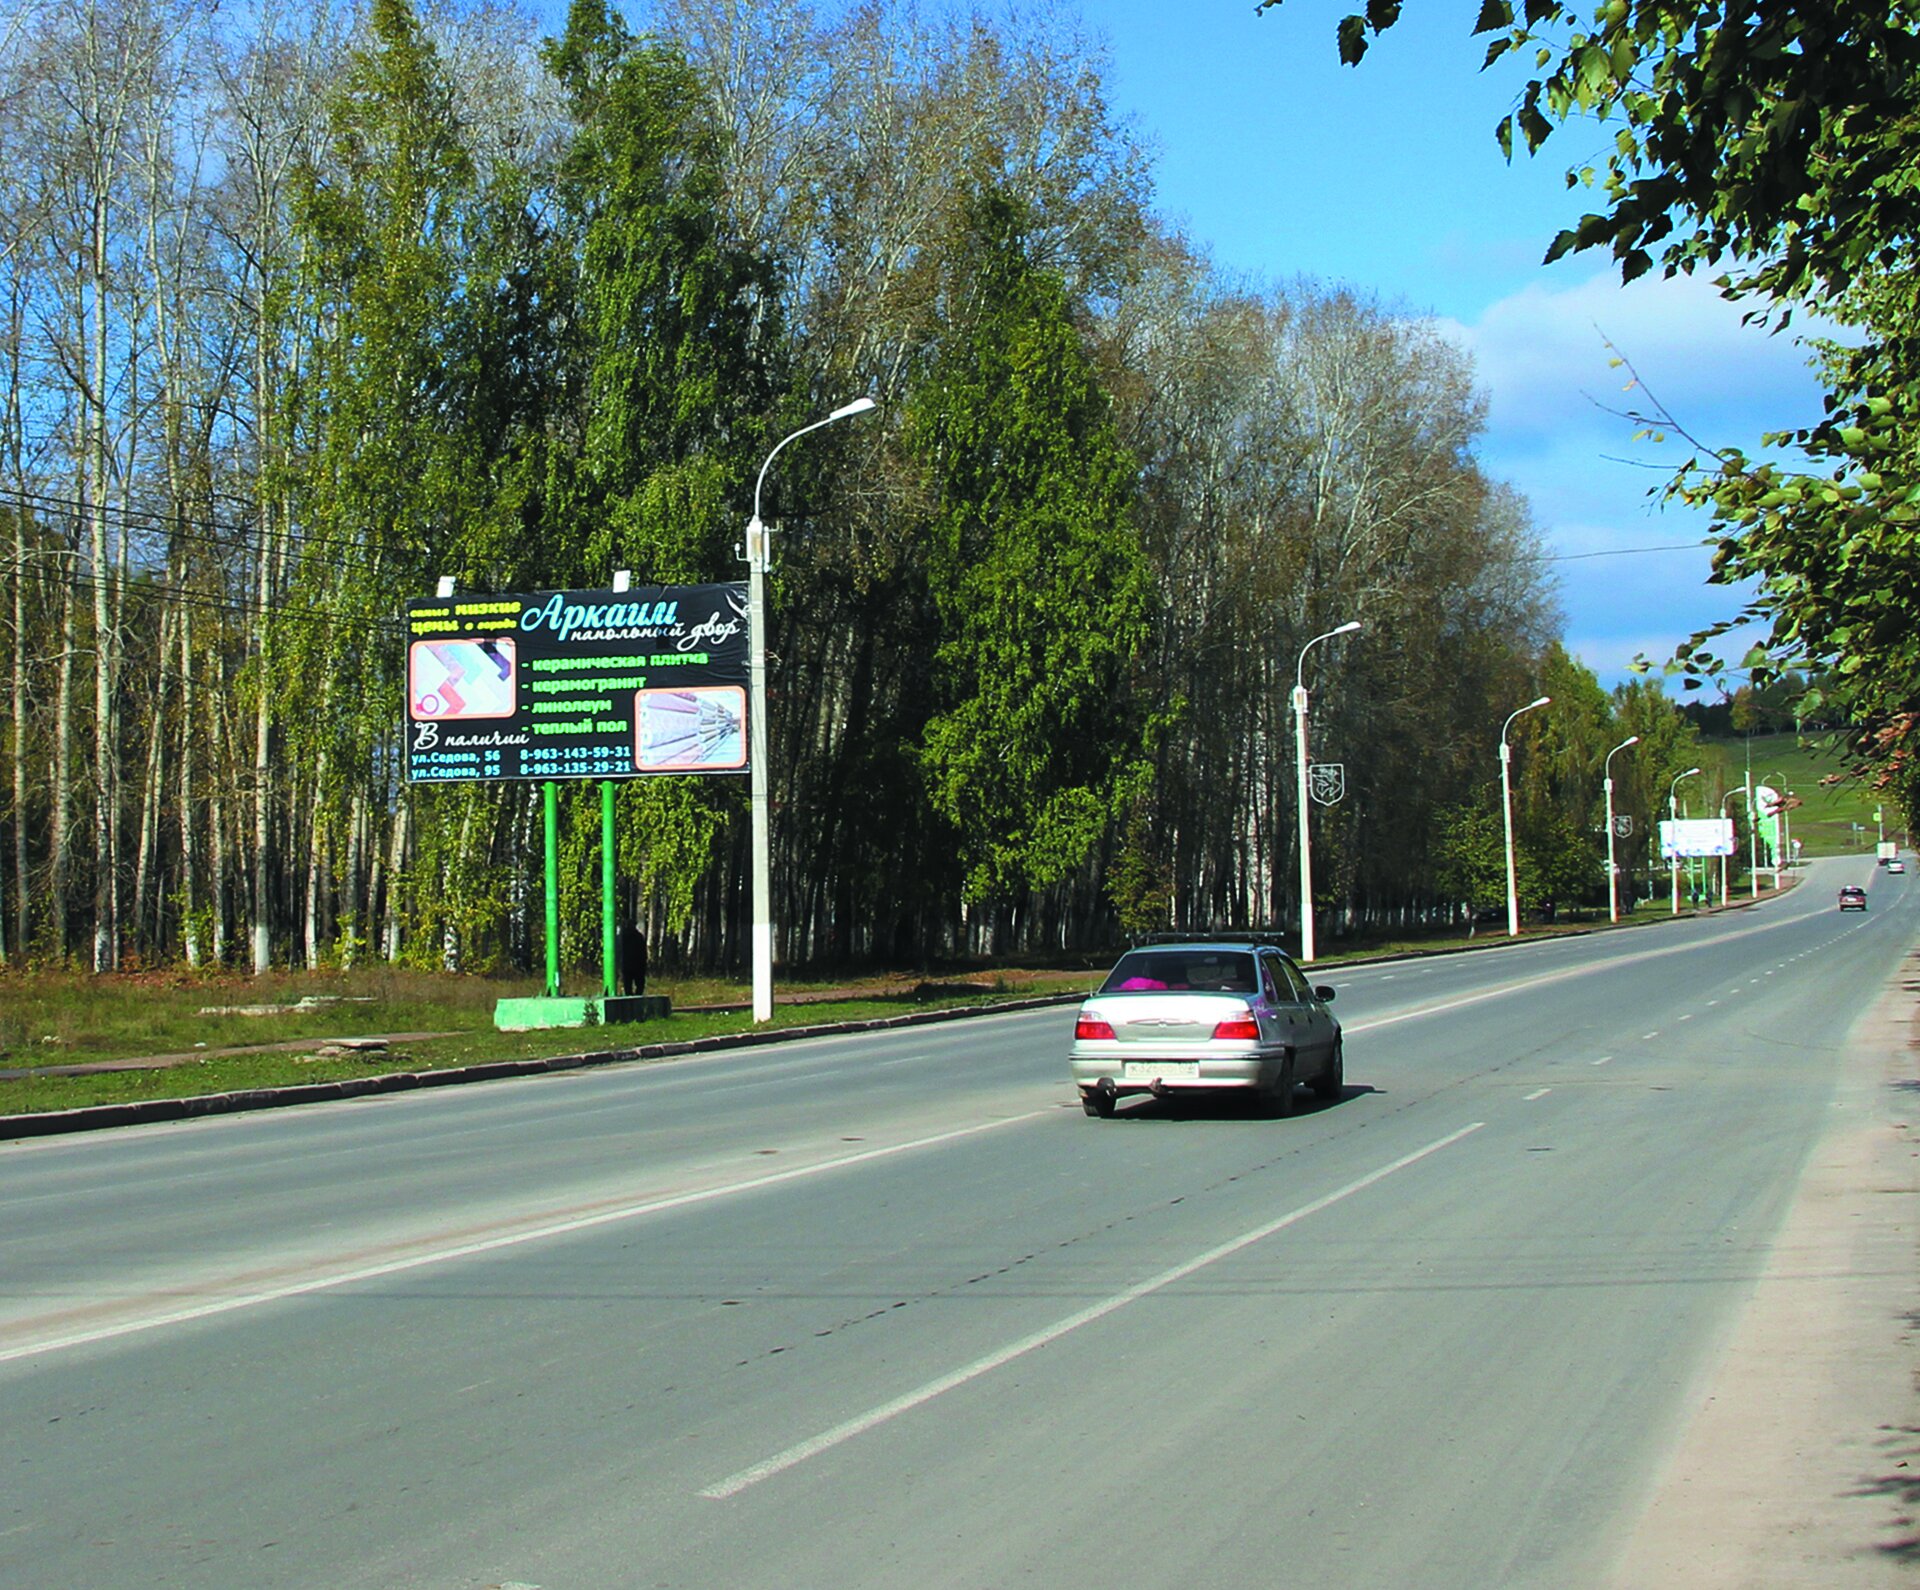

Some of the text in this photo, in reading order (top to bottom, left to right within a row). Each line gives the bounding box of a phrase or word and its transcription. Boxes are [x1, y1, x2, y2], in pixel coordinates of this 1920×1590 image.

[455, 601, 522, 616] низкие
[520, 593, 678, 641] Аркаим
[410, 620, 460, 636] цены
[532, 652, 709, 674] керамическая плитка
[532, 676, 647, 695] керамогранит
[532, 699, 612, 715] линолеум
[532, 718, 628, 736] теплый пол
[412, 721, 530, 752] В наличии
[484, 750, 501, 762] 56
[519, 746, 631, 760] 8-963-143-59-31
[484, 764, 501, 776] 95
[519, 761, 631, 775] 8-963-135-29-21
